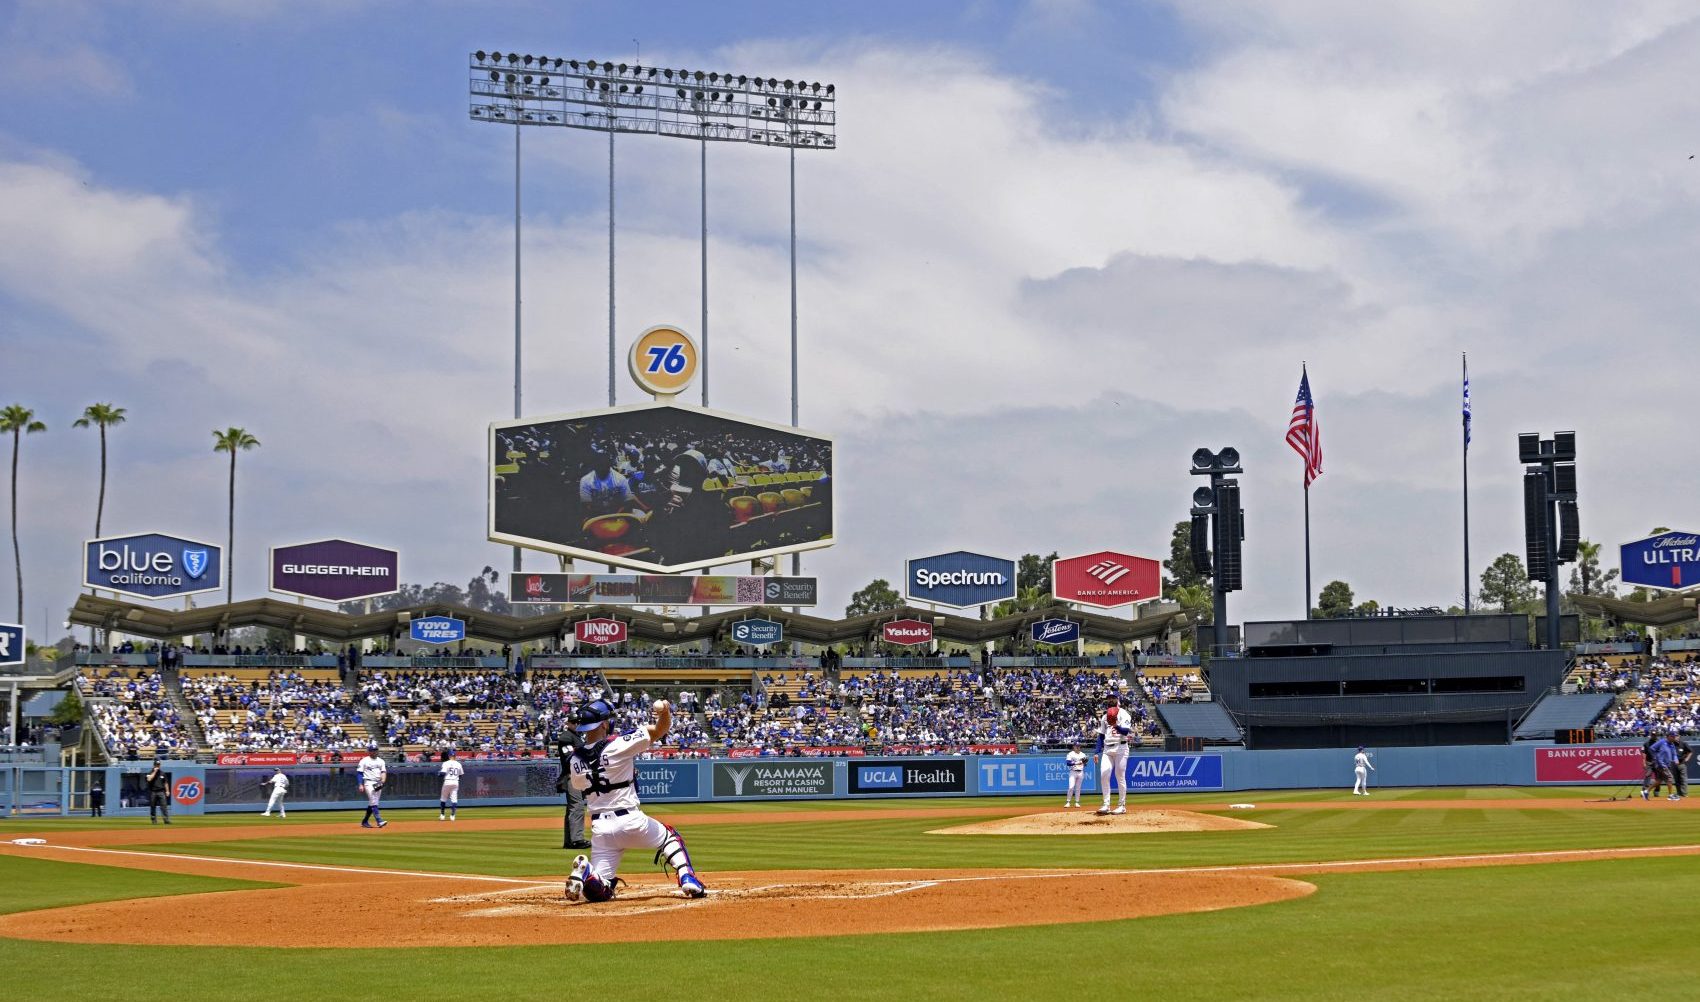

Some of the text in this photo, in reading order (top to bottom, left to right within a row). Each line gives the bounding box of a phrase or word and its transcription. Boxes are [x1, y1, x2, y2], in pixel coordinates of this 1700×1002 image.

[645, 343, 687, 375] 76
[1653, 536, 1697, 548] Michelob
[100, 544, 173, 572] blue
[282, 564, 389, 576] GUGGENHEIM
[110, 573, 181, 586] california
[916, 568, 1002, 589] Spectrum
[783, 583, 813, 592] Security
[783, 591, 810, 599] Benefit
[417, 622, 450, 630] TOYO
[583, 623, 619, 638] JINRO
[751, 625, 778, 633] Security
[886, 628, 930, 636] Yakult
[1038, 622, 1073, 640] Jostens
[422, 630, 459, 638] TIRES
[1547, 748, 1642, 758] BANK OF AMERICA
[449, 767, 459, 776] 50
[1131, 760, 1175, 777] ANA
[864, 771, 898, 783] UCLA
[906, 769, 955, 784] Health
[982, 763, 1035, 787] TEL
[178, 781, 200, 799] 76
[1131, 780, 1167, 788] Inspiration
